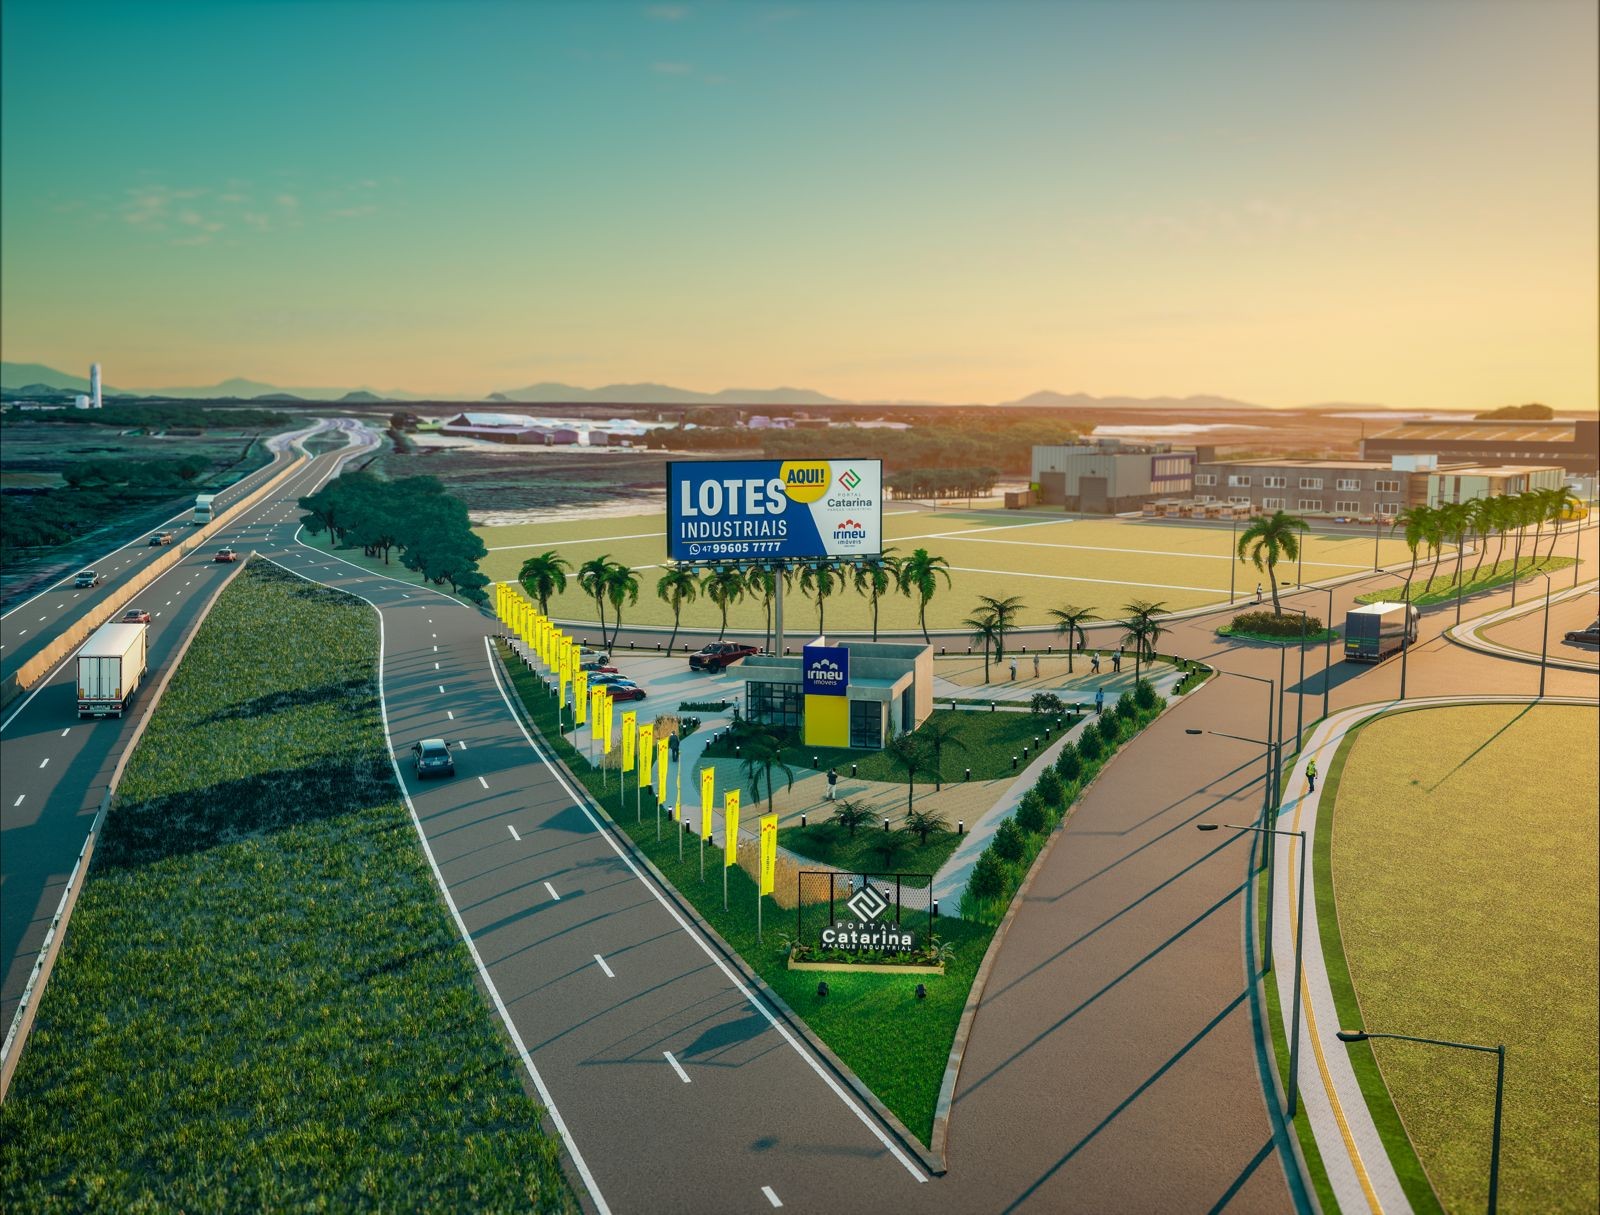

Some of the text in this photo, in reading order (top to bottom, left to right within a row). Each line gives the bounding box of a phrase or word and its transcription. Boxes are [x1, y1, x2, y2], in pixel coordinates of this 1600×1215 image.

[787, 468, 825, 485] AQUI!
[681, 478, 787, 517] LOTES
[827, 498, 872, 508] Catarina
[681, 519, 788, 539] INDUSTRIAIS
[702, 542, 781, 554] 47 99605 7777
[837, 922, 897, 931] PORTAL
[822, 929, 912, 946] Catarina
